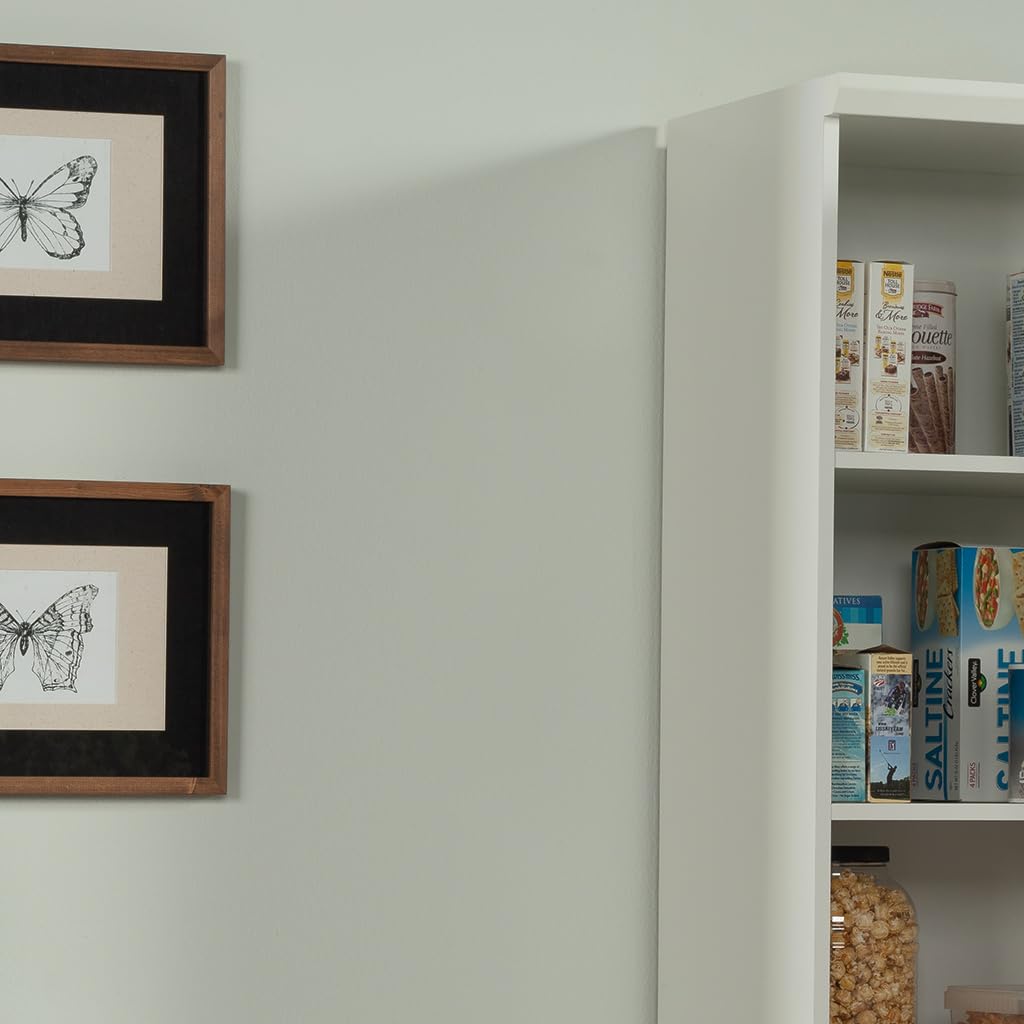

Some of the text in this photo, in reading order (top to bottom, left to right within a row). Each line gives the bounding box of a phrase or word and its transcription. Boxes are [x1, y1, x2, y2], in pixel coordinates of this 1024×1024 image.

[912, 330, 953, 346] ouette
[925, 648, 943, 791] SALTINE
[943, 648, 954, 720] Crackers
